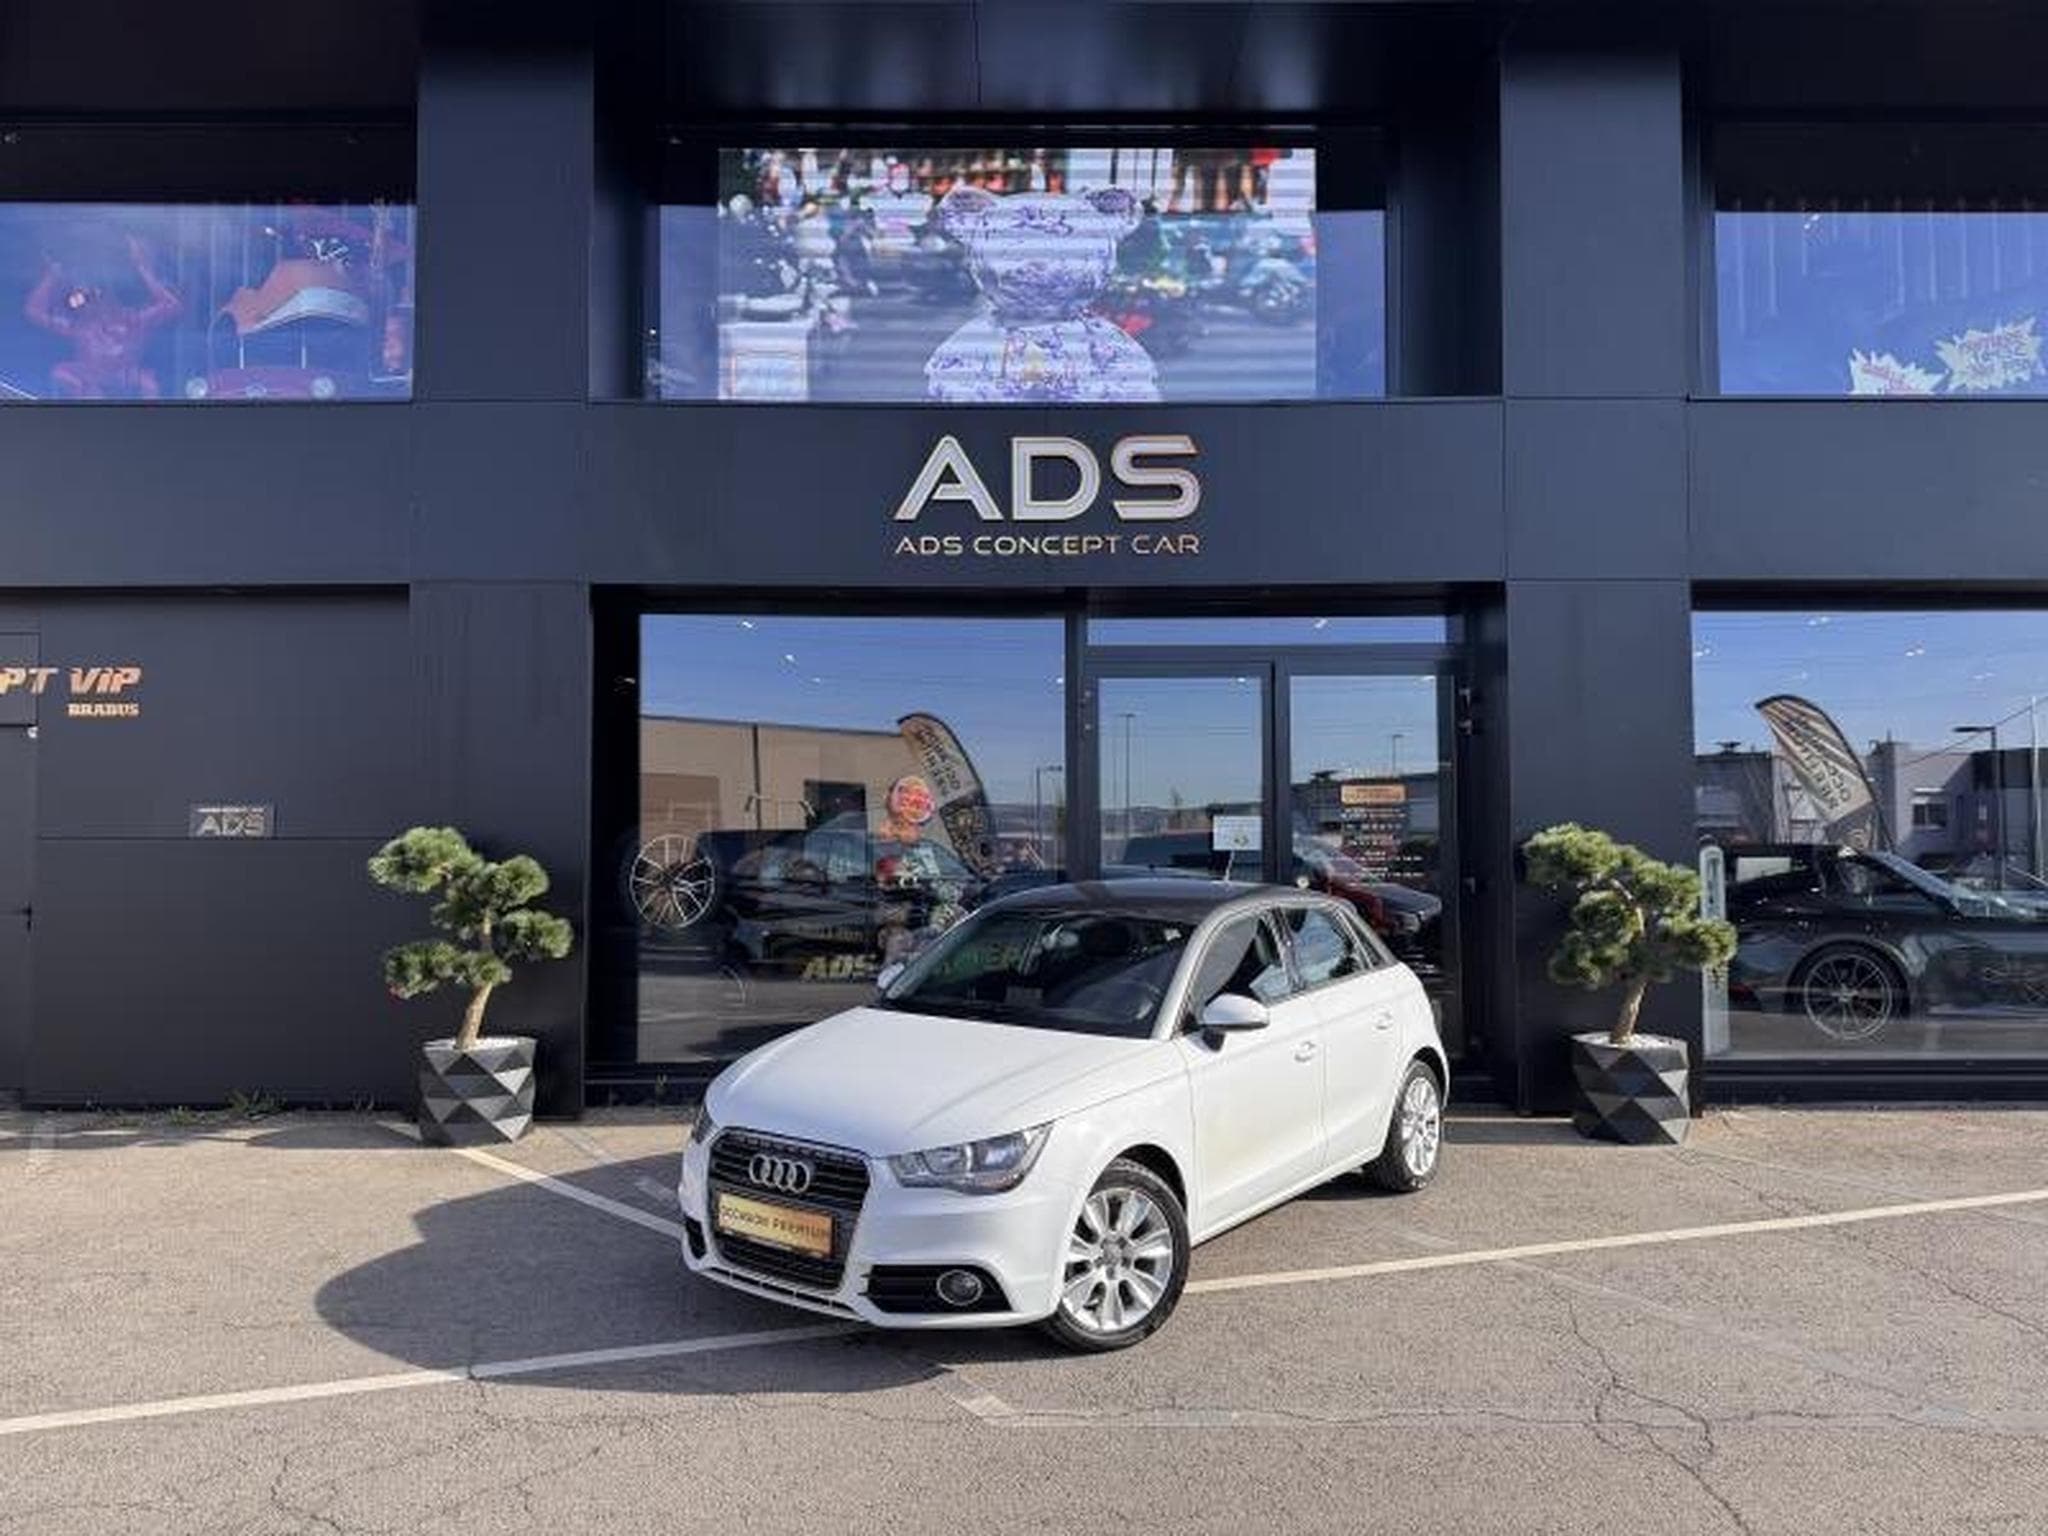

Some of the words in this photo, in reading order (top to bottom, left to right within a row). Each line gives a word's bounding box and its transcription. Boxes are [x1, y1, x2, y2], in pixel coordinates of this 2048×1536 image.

[894, 435, 1200, 521] ADS
[895, 536, 963, 555] ADS
[973, 535, 1117, 555] CONCEPT
[1131, 534, 1200, 554] CAR
[67, 702, 140, 717] BRABUS
[195, 814, 266, 837] ADS
